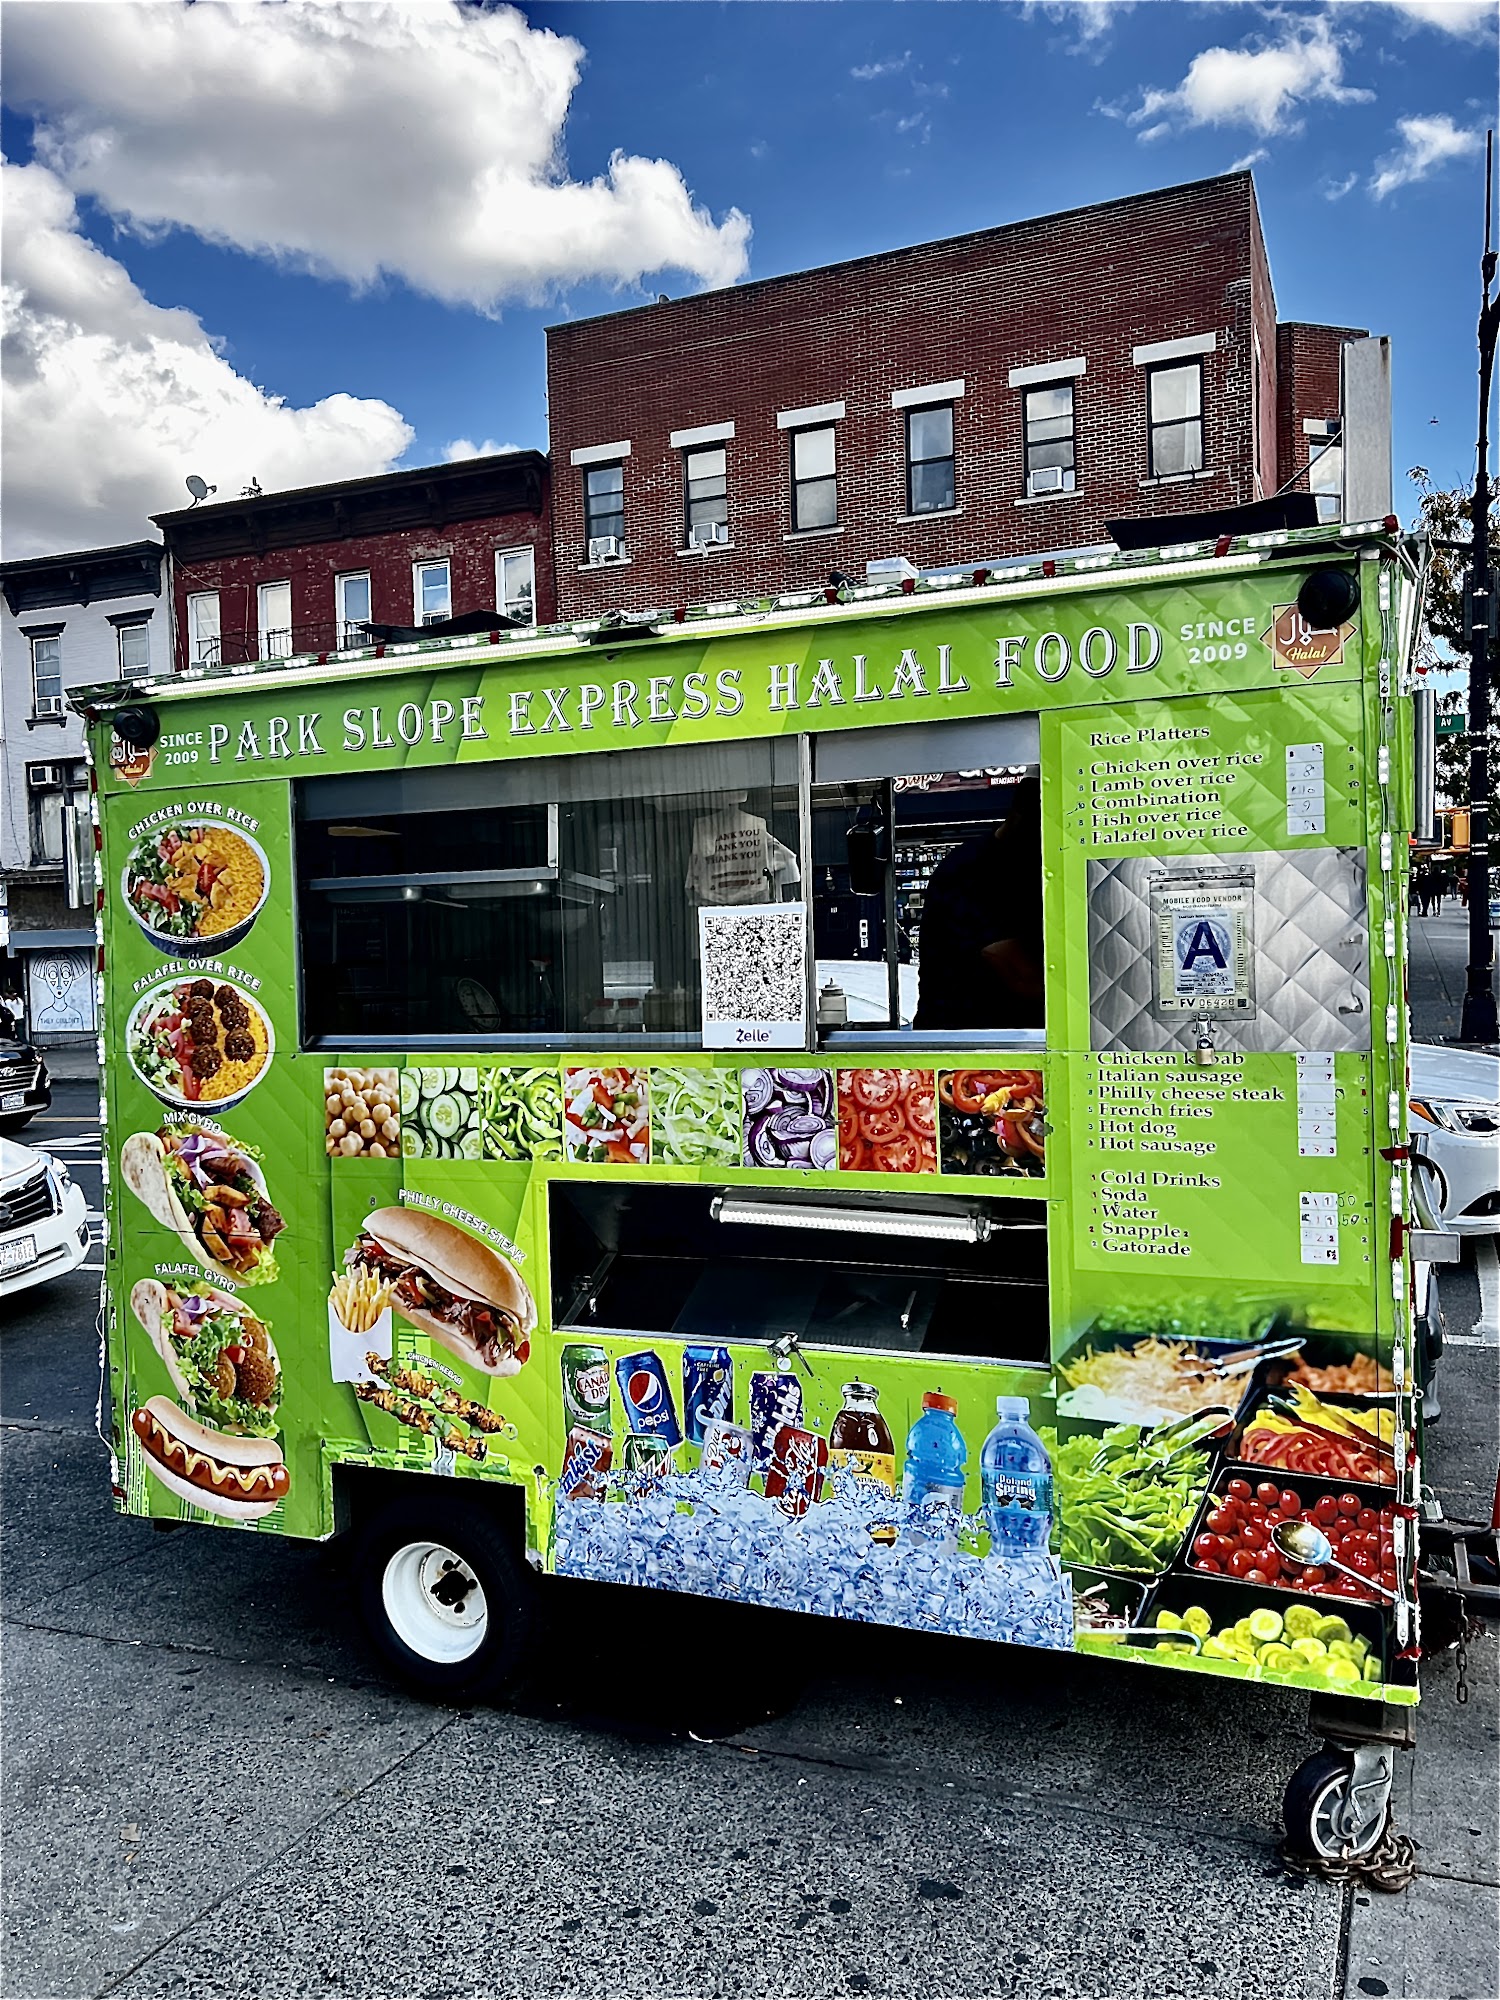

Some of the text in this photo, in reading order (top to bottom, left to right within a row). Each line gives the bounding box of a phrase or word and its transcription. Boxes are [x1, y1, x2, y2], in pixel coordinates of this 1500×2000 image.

[1180, 617, 1256, 641] SINCE
[1188, 642, 1248, 664] 2009
[1286, 645, 1327, 661] Halal
[208, 622, 1163, 764] PARK SLOPE EXPRESS HALAL FOOD
[160, 731, 204, 749] SINCE
[1090, 726, 1210, 747] Rice Platters
[165, 750, 199, 766] 2009
[1091, 751, 1263, 776] Chicken over rice
[1091, 771, 1236, 793] Lamb over rice
[1091, 790, 1220, 810] Combination
[128, 801, 260, 840] CHICKEN OVER RICE
[1092, 807, 1222, 828] Fish over rice
[739, 829, 760, 838] YOU
[1092, 823, 1248, 845] Falafel over rice
[739, 839, 761, 848] YOU
[740, 850, 761, 860] YOU
[1162, 894, 1242, 905] MOBILE FOOD VENDOR
[1181, 921, 1228, 971] A
[132, 958, 262, 994] FALAFEL OVER RICE
[1180, 998, 1196, 1007] FV
[736, 1028, 769, 1044] Zelle
[1097, 1052, 1244, 1065] Chicken kab
[1097, 1069, 1243, 1086] Italian sausage
[1099, 1086, 1285, 1103] Philly cheese steak
[1099, 1103, 1213, 1117] French fries
[163, 1111, 222, 1134] MIX GYRO
[1099, 1120, 1177, 1137] Hot dog
[1100, 1137, 1216, 1156] Hot sausage
[1100, 1170, 1220, 1188] Cold Drinks
[1101, 1188, 1148, 1201] Soda
[1102, 1204, 1158, 1219] Water
[398, 1188, 527, 1265] PHILLY CHEESE STEAK
[1102, 1222, 1181, 1240] Snapple
[1103, 1239, 1191, 1255] Gatorade
[154, 1262, 237, 1294] FALAFEL GYRO
[407, 1352, 463, 1386] CHICKEN KEBAB
[591, 1386, 609, 1400] DRY
[638, 1408, 670, 1429] pepsi
[762, 1382, 800, 1447] Wlch's
[706, 1427, 721, 1458] Diet
[561, 1439, 603, 1494] nkist
[999, 1473, 1032, 1486] Poland
[995, 1482, 1037, 1501] Spring
